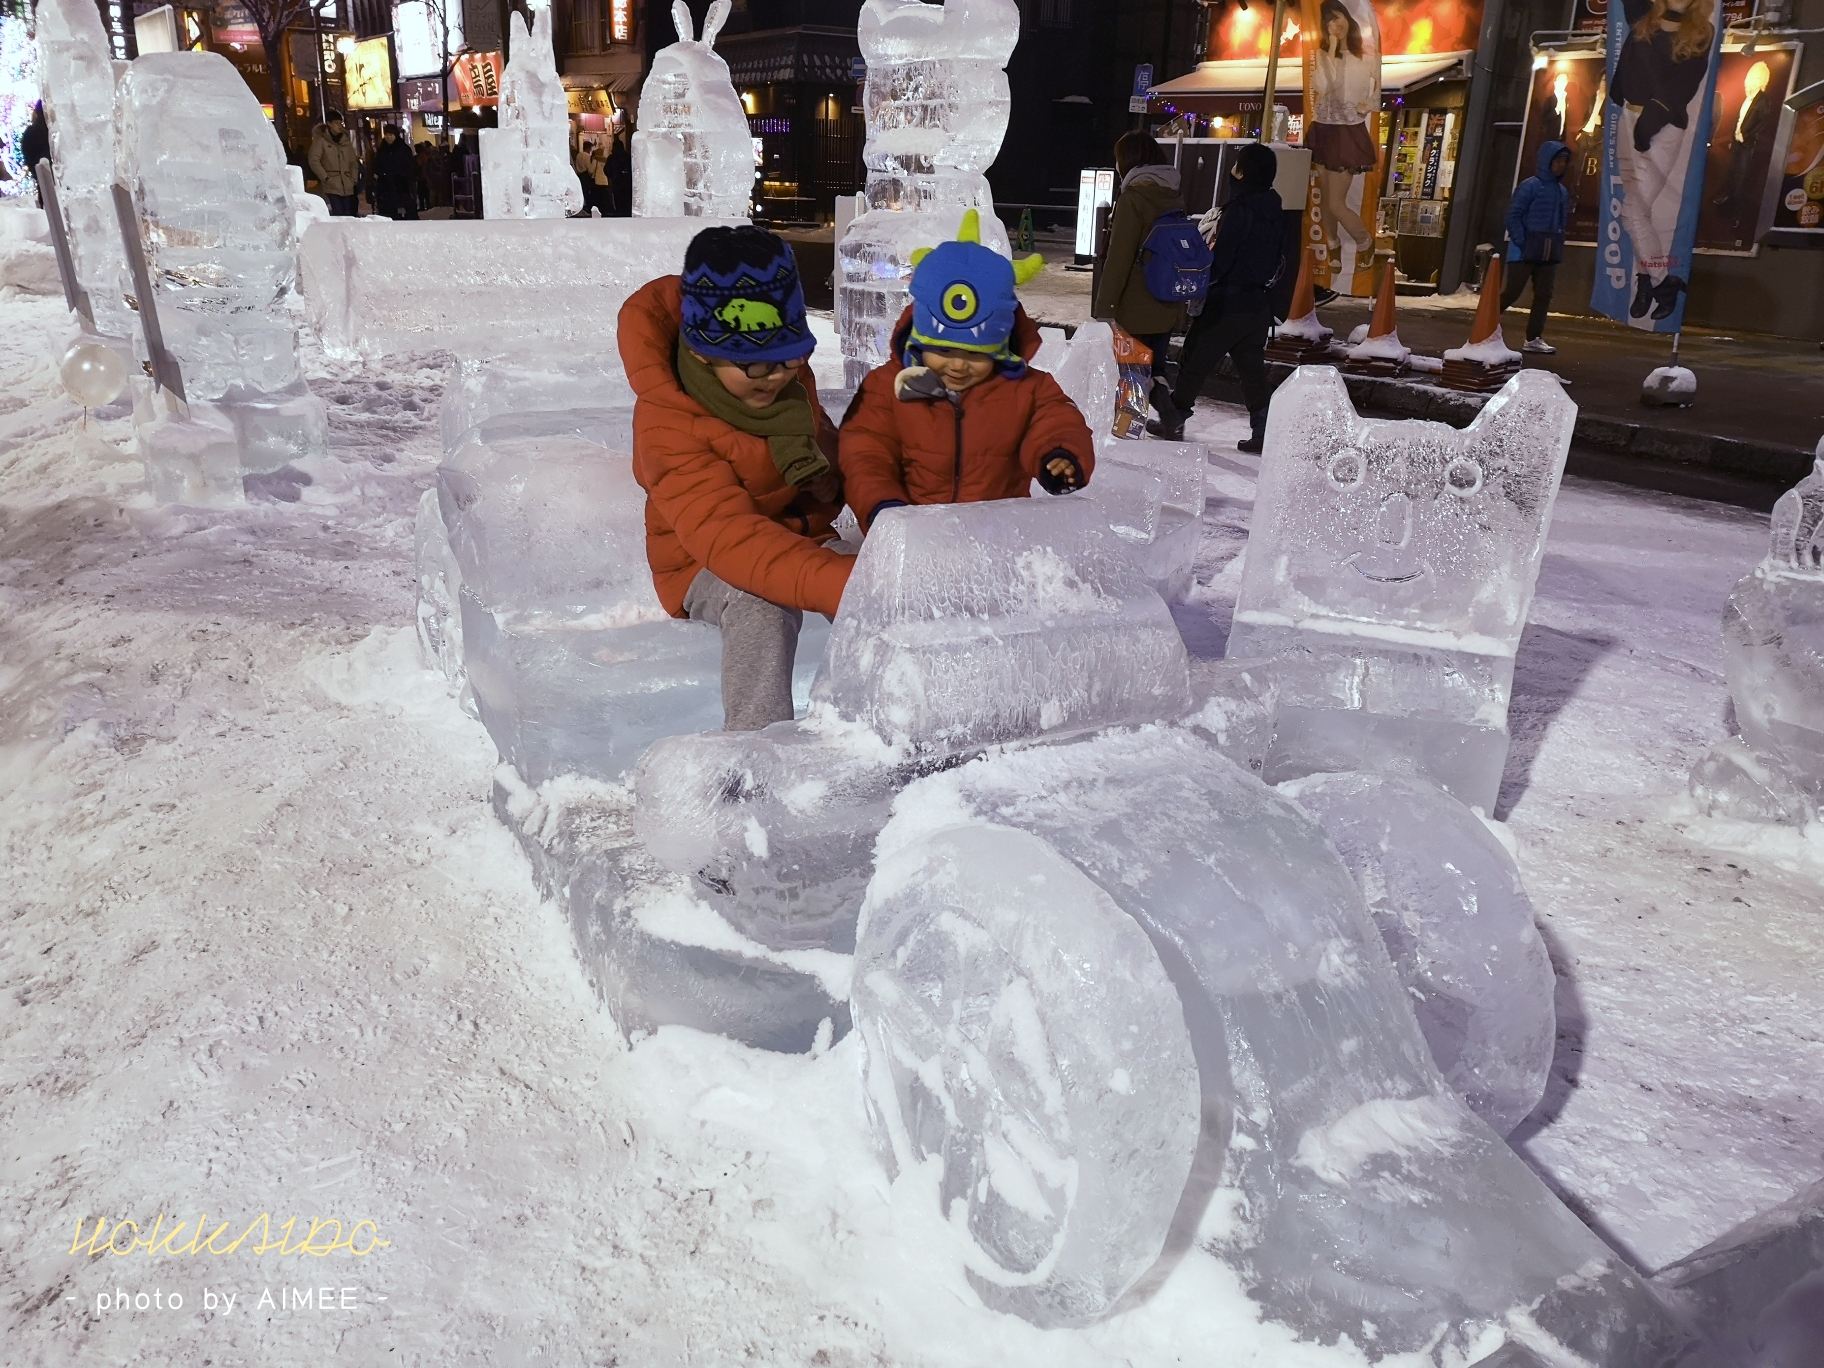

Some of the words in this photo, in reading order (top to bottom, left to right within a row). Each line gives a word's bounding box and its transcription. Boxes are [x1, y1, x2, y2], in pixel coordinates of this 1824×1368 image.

[321, 33, 337, 73] ZERO
[1137, 71, 1149, 90] 停
[1425, 149, 1436, 187] クラシック
